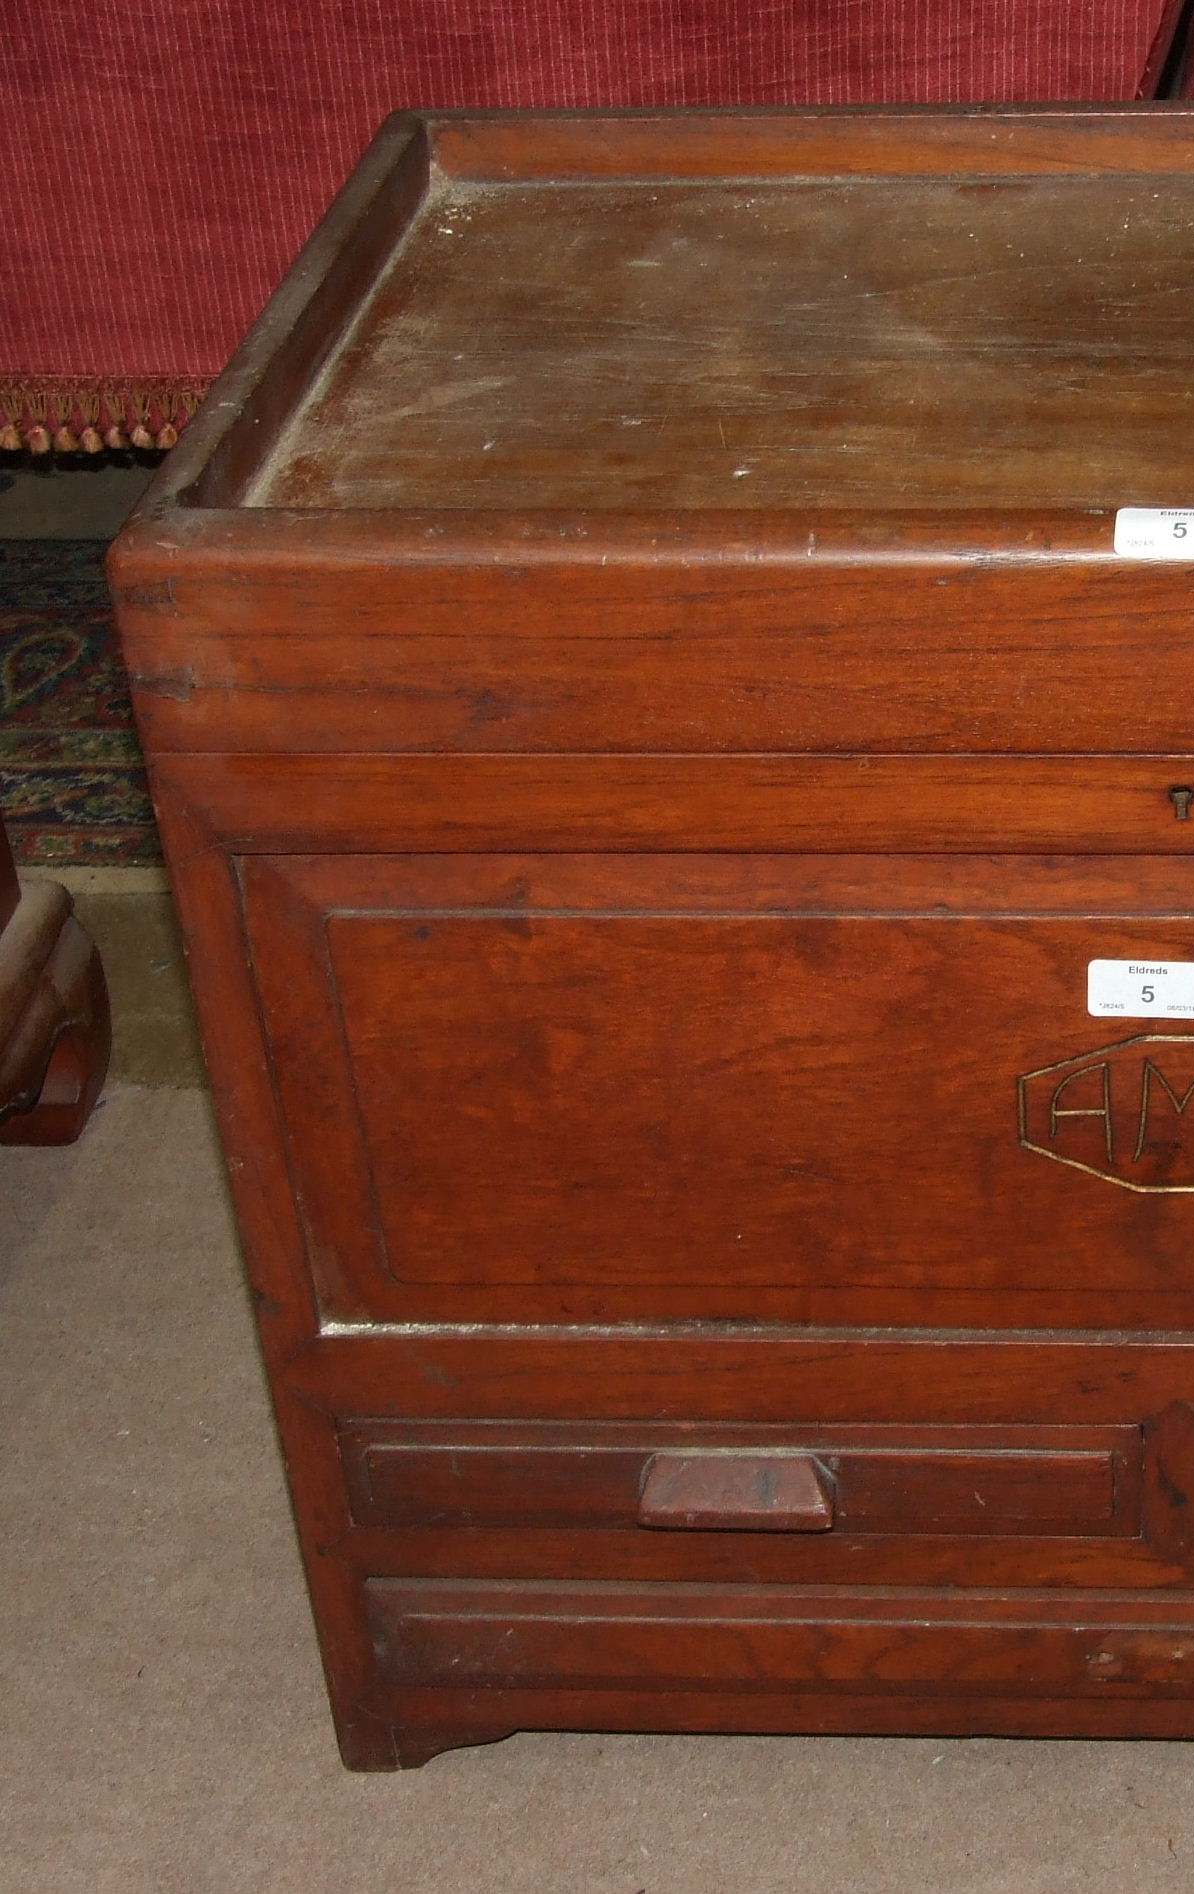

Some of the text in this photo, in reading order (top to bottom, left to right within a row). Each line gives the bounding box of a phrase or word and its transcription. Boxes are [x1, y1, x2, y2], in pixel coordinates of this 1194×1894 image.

[1172, 522, 1188, 539] 5
[1128, 965, 1168, 975] Eldreds
[1141, 985, 1155, 1003] 5
